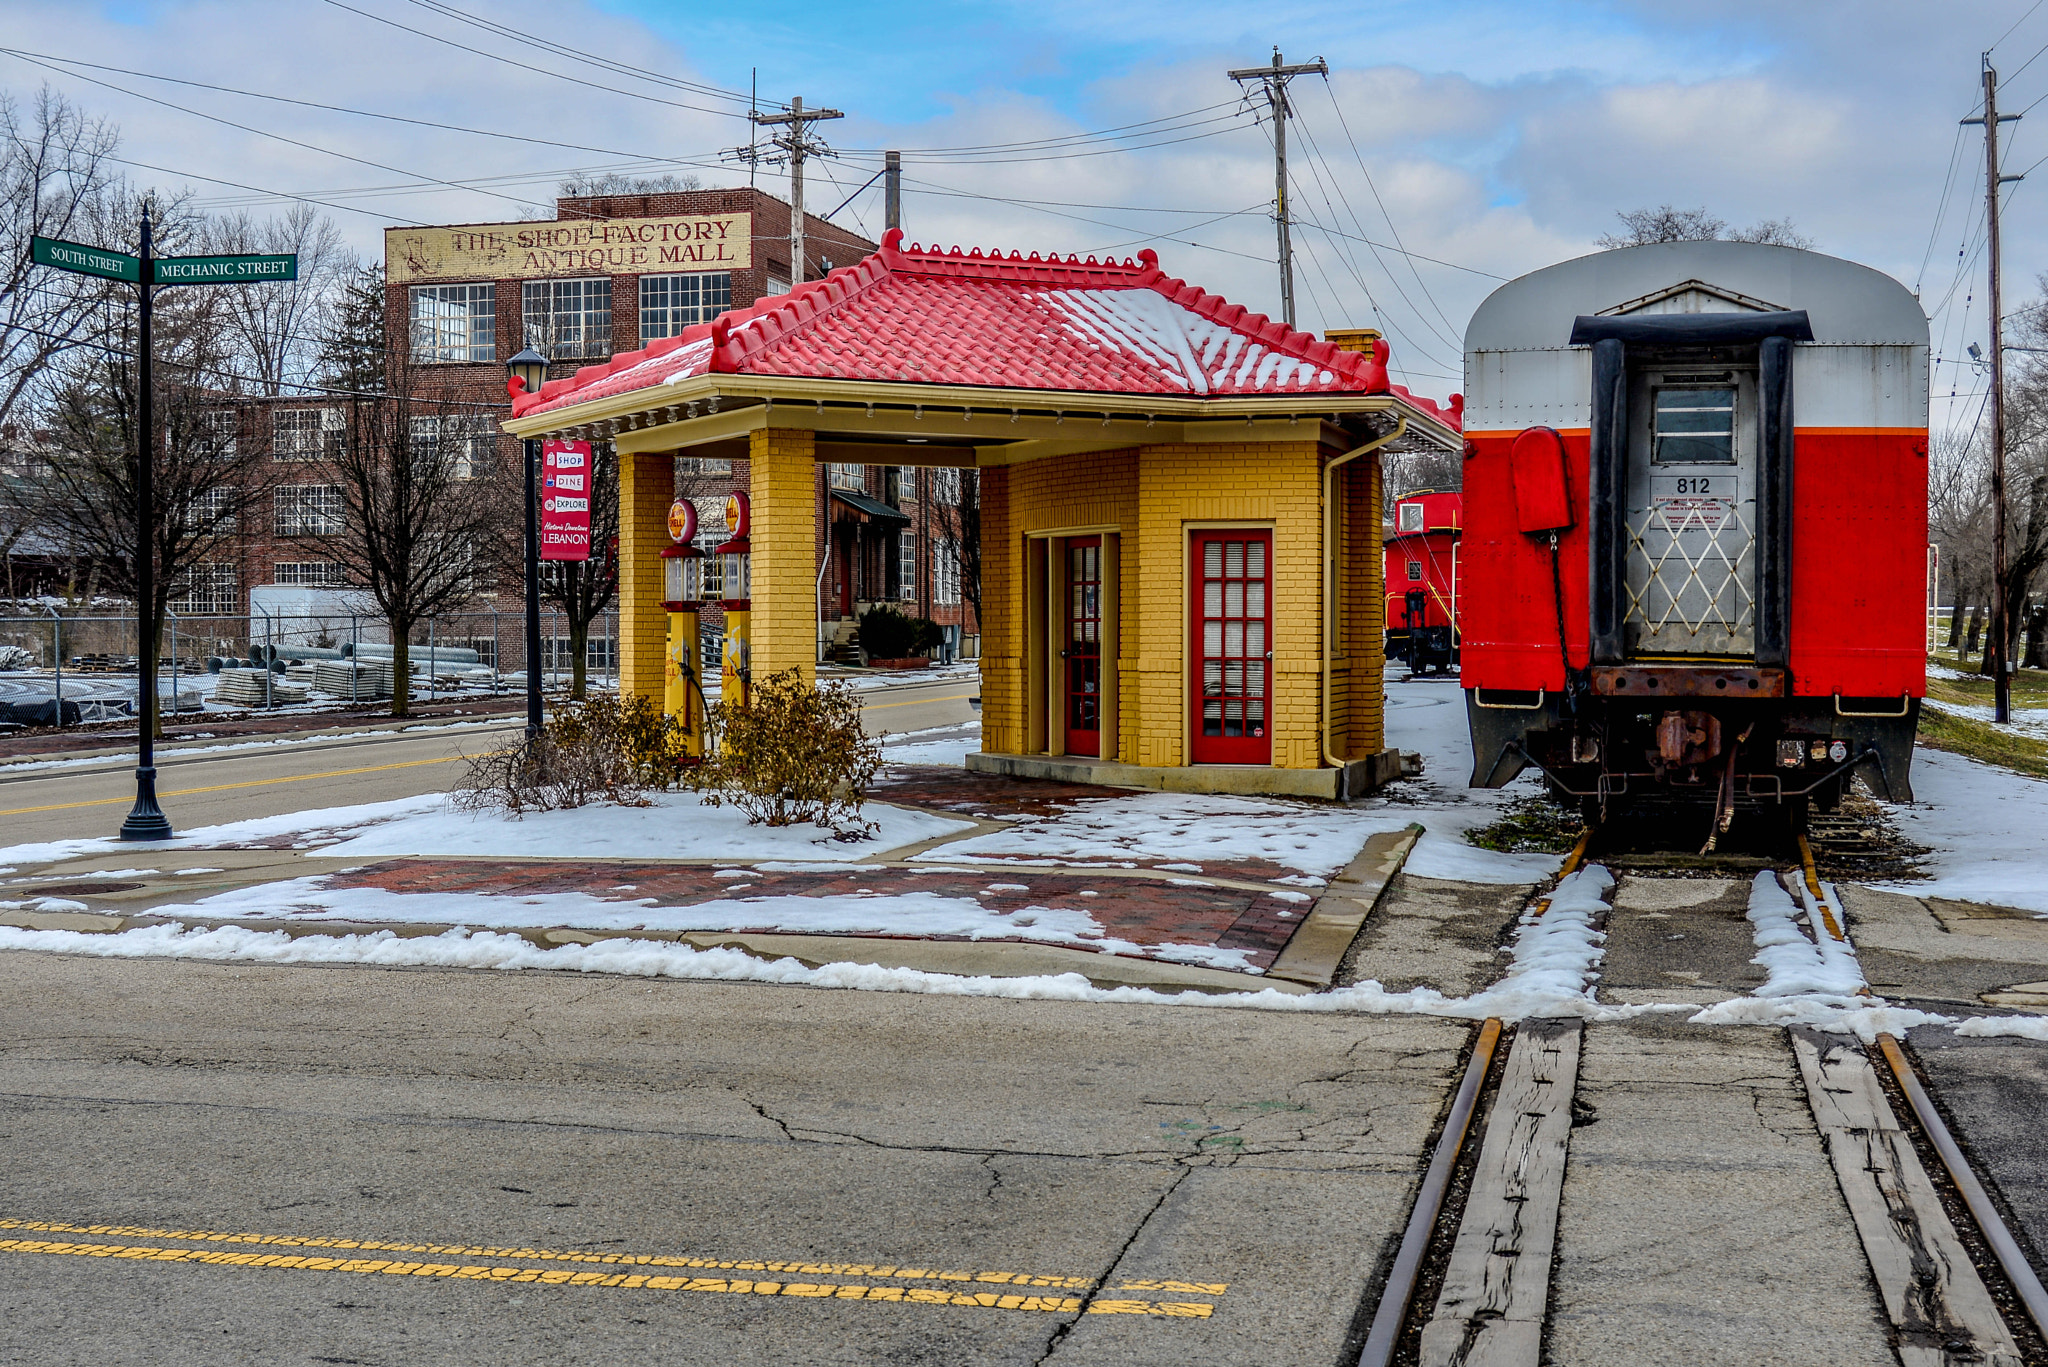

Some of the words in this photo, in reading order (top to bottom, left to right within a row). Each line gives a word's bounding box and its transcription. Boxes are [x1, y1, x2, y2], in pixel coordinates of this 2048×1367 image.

[451, 231, 505, 252] THE
[517, 227, 591, 249] SHOE
[602, 220, 734, 244] FACTORY
[50, 246, 87, 267] SOUTH
[88, 255, 125, 273] STREET
[522, 246, 650, 271] ANTIQUE
[658, 243, 736, 264] MALL
[160, 262, 235, 278] MECHANIC
[237, 260, 289, 276] STREET
[558, 457, 583, 465] SHOP
[558, 478, 582, 486] DINE
[1677, 478, 1710, 494] 812
[557, 500, 587, 509] EXPLORE
[669, 518, 683, 528] SHELL
[544, 533, 588, 545] LEBANON
